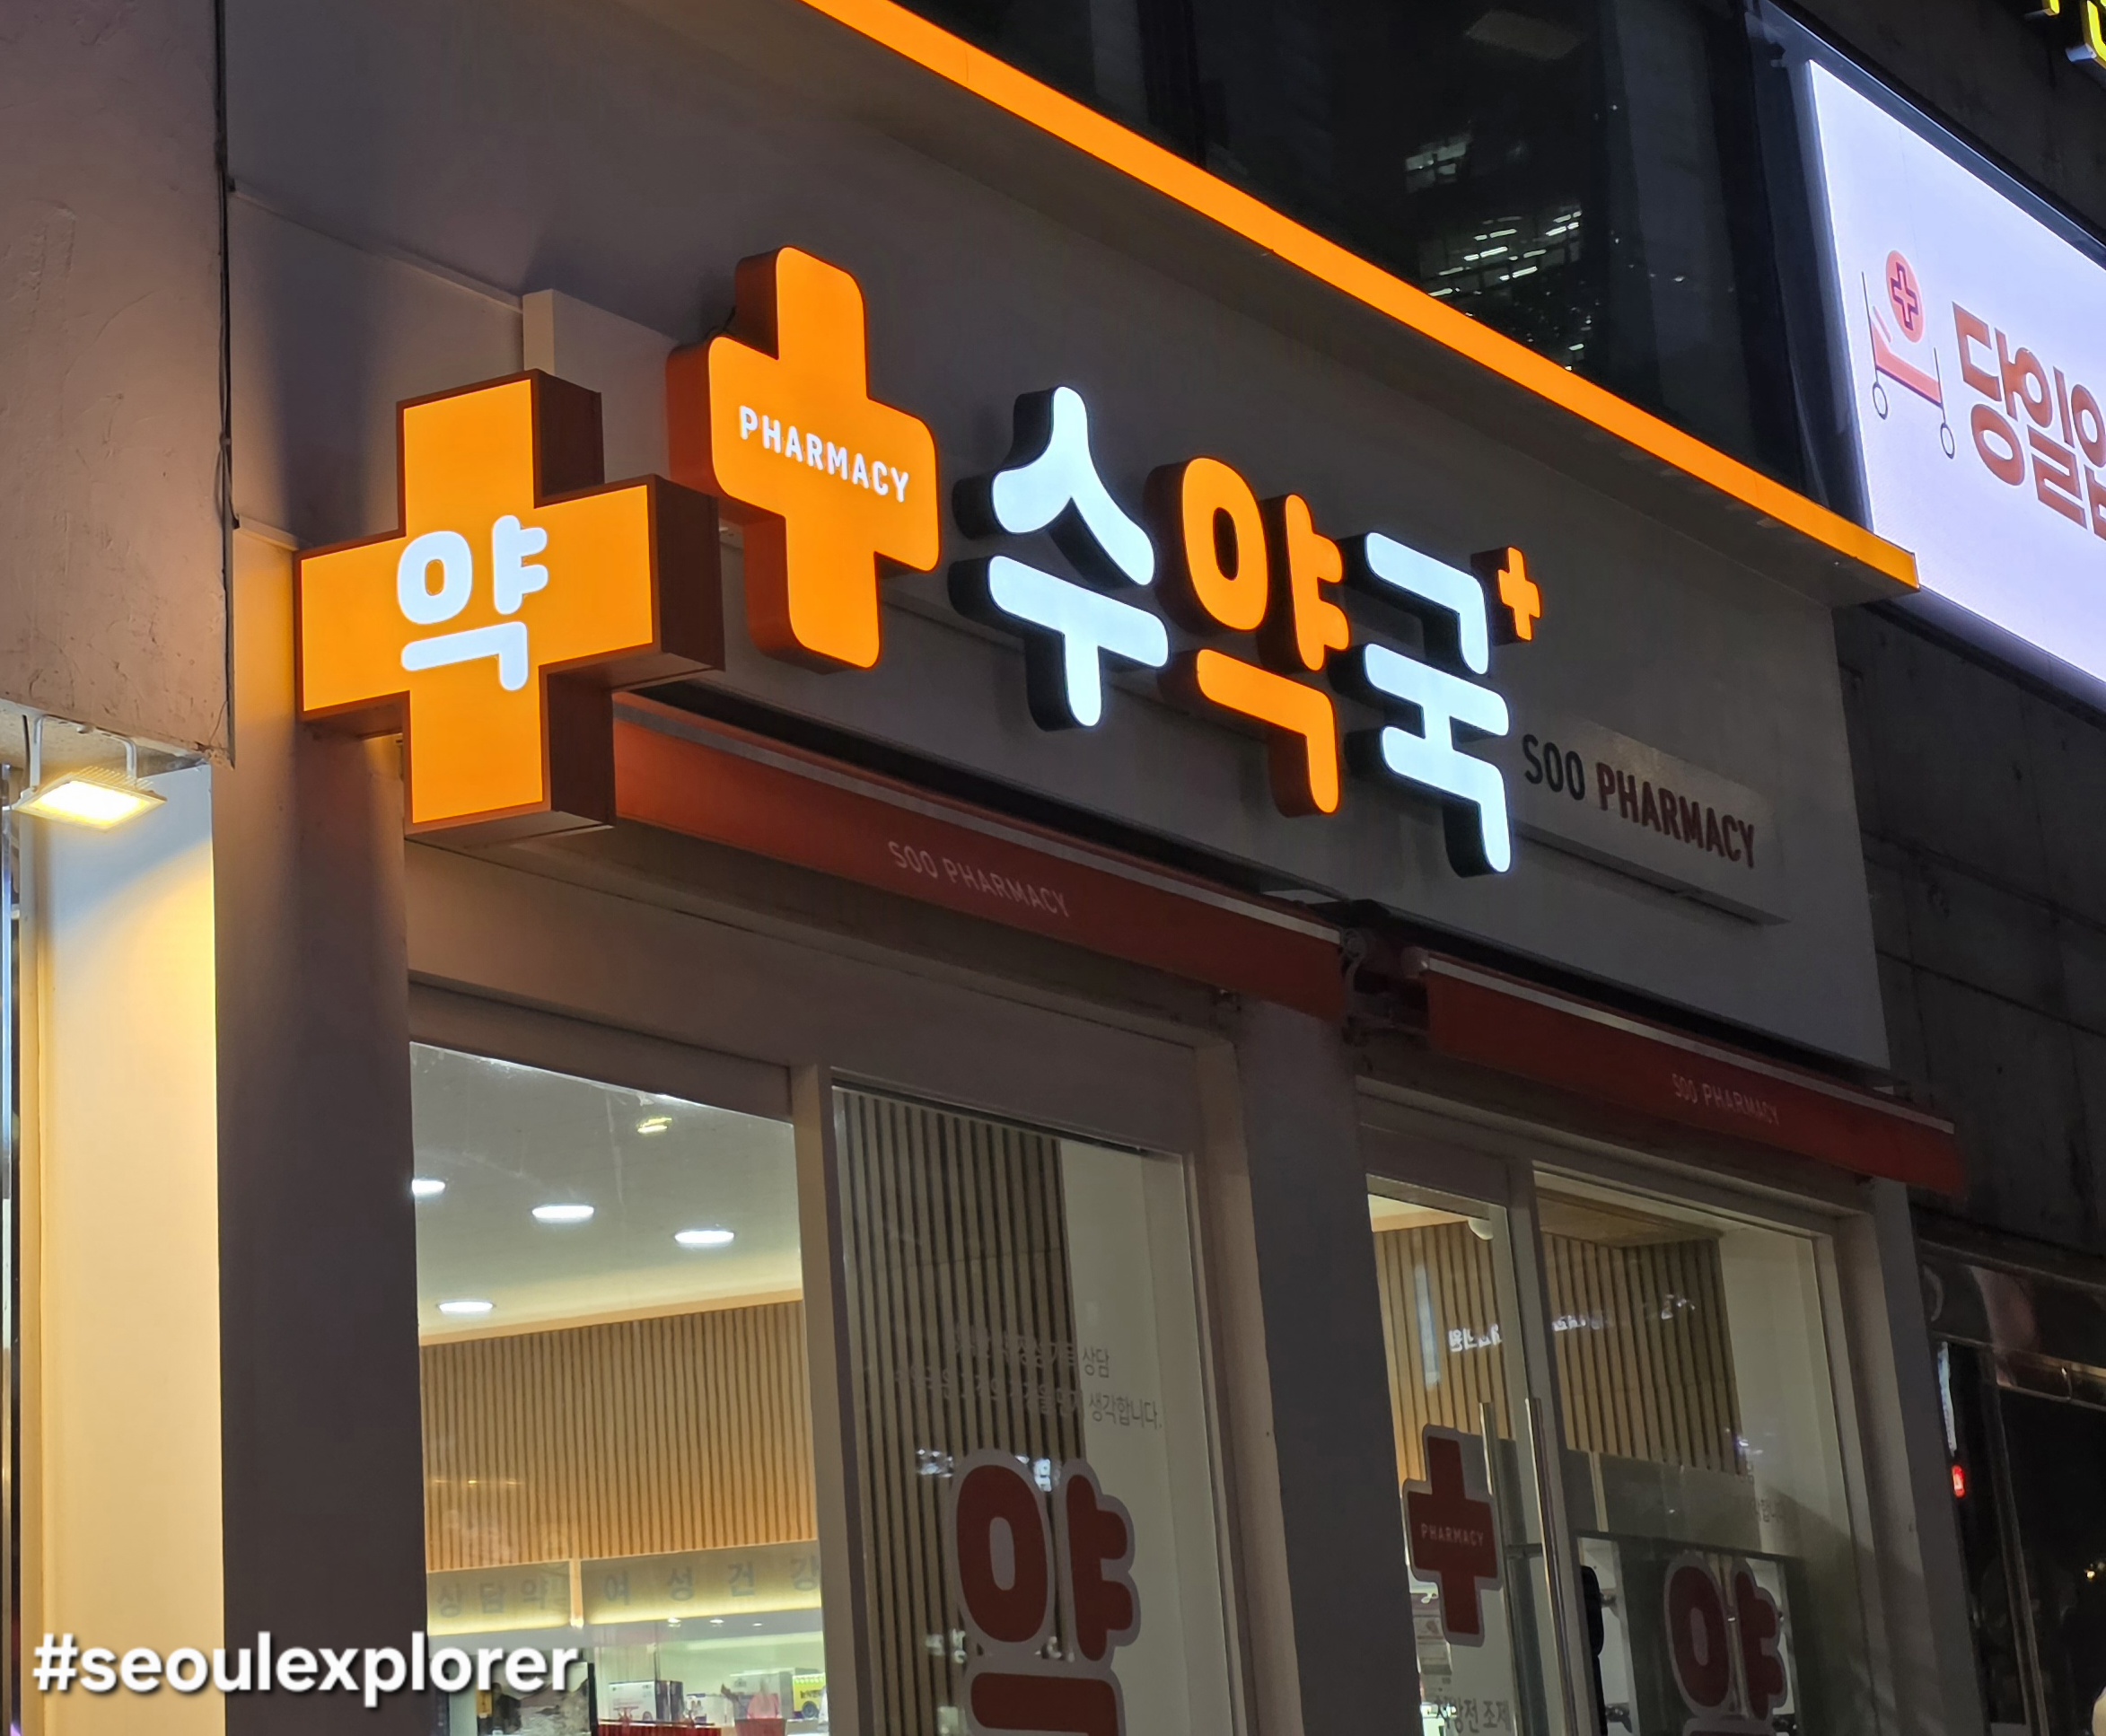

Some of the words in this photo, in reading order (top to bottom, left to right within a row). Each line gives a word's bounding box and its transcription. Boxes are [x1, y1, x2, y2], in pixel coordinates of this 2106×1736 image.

[738, 405, 910, 504] PHARMACY
[397, 514, 548, 691] 약
[988, 385, 1512, 873] 수약국
[1522, 732, 1585, 801] SOO
[1597, 762, 1755, 869] PHARMACY
[887, 840, 939, 879] SOO
[941, 858, 1071, 917] PHARMACY
[1671, 1073, 1698, 1105] SOO
[1701, 1083, 1780, 1126] PHARMACY
[1082, 1346, 1110, 1379] 상담
[1089, 1390, 1163, 1430] 생각합니다.
[1420, 1522, 1485, 1547] PHARMACY
